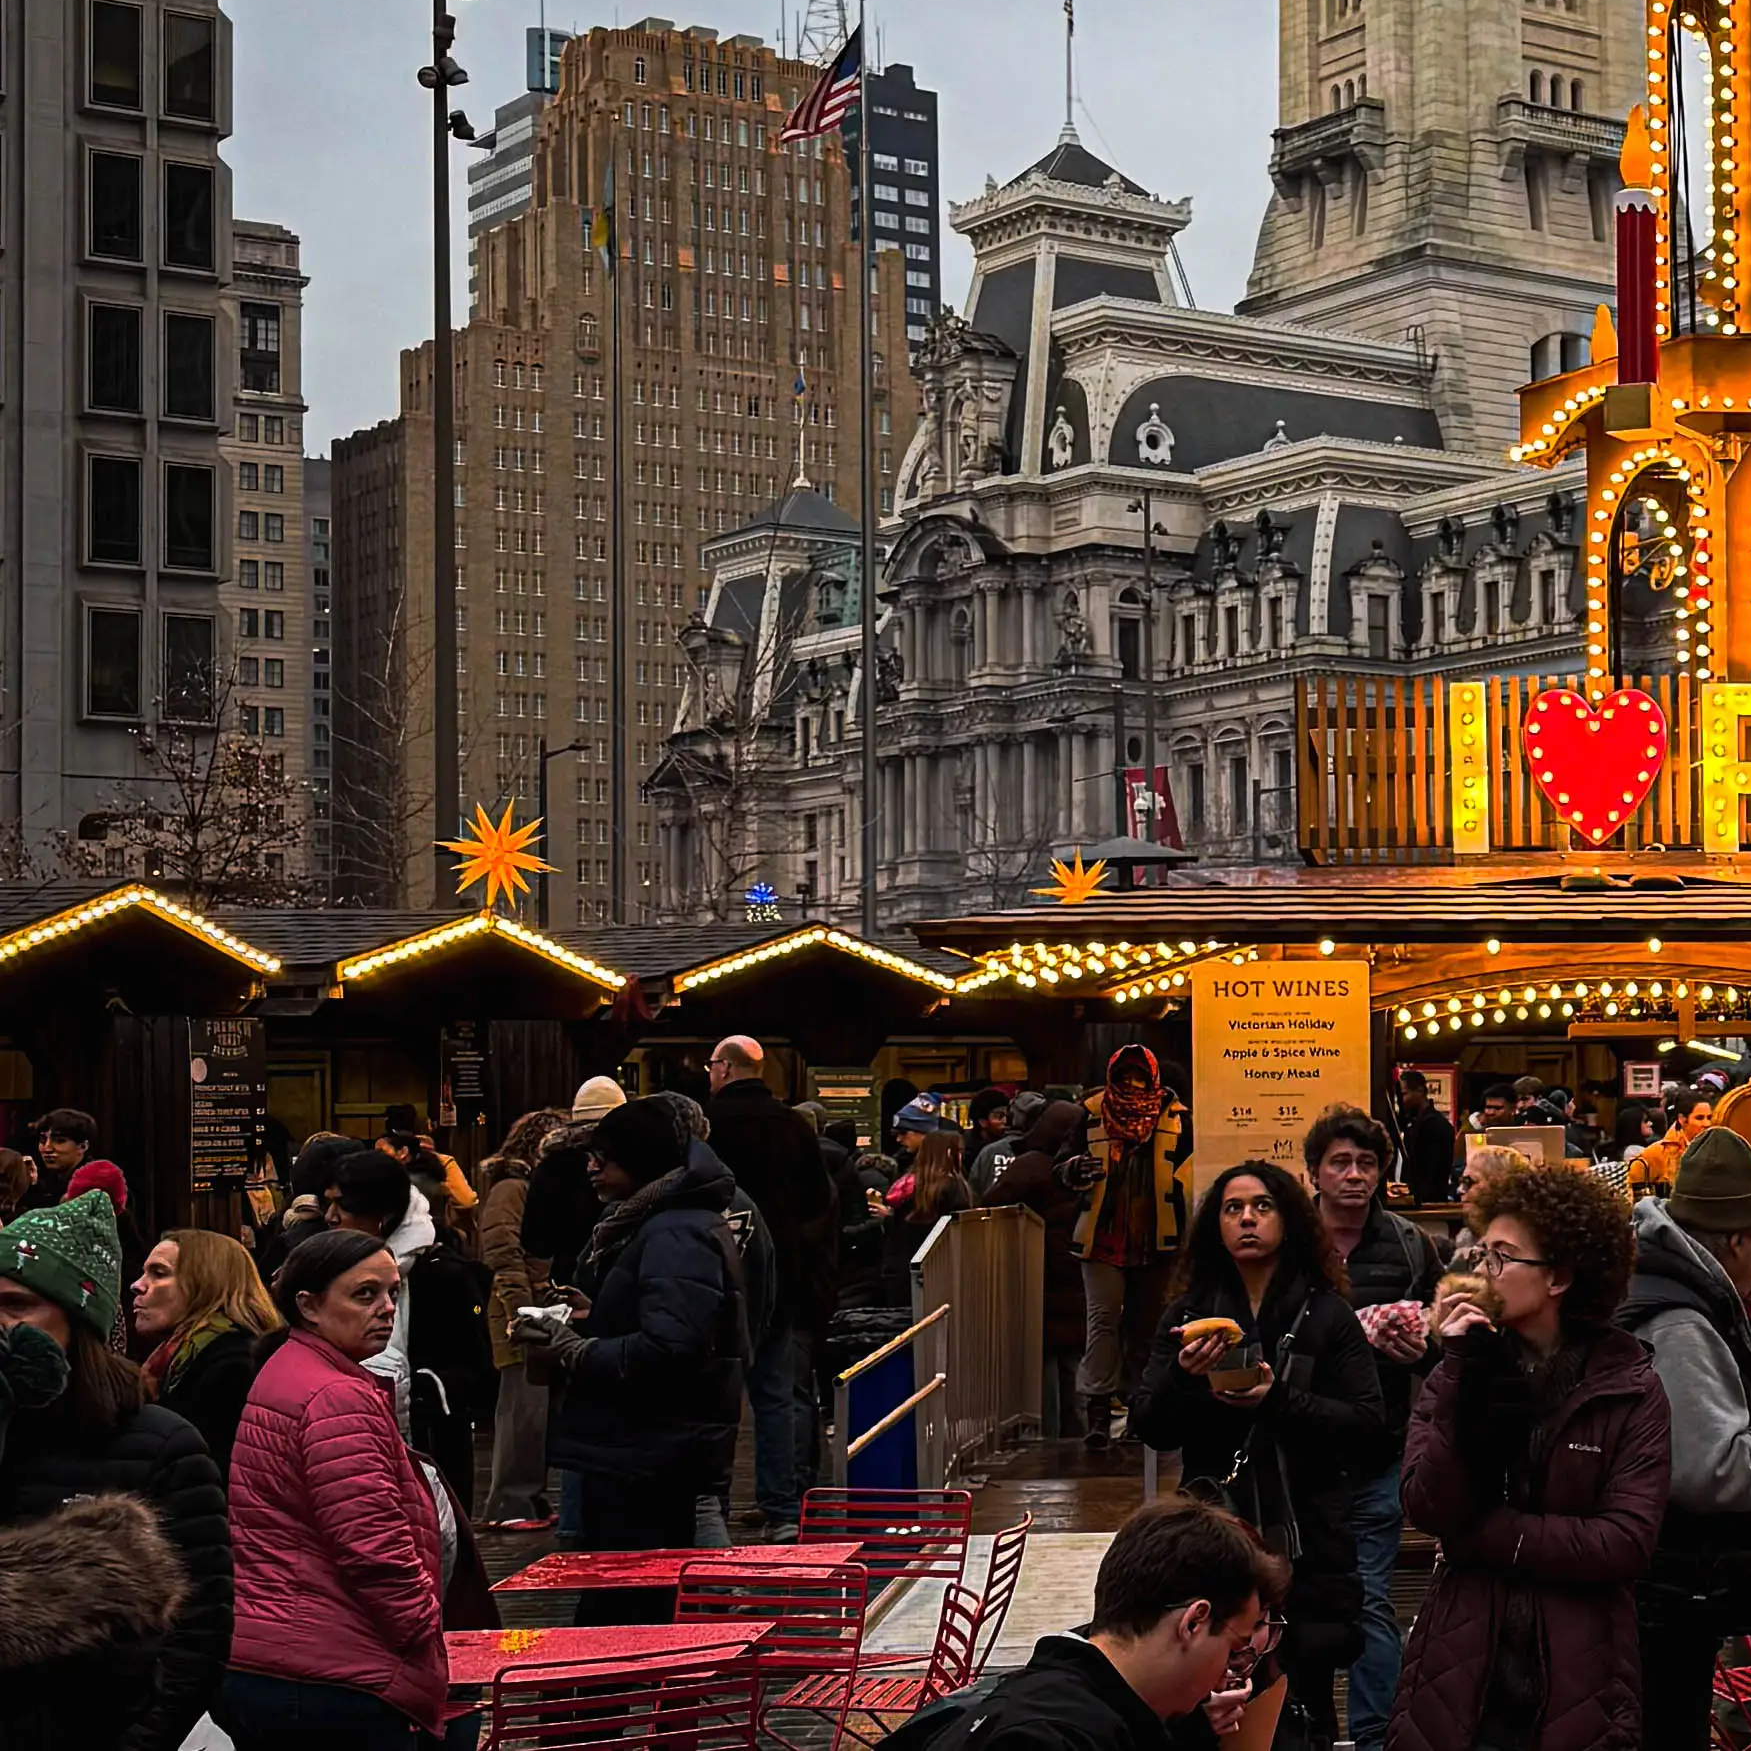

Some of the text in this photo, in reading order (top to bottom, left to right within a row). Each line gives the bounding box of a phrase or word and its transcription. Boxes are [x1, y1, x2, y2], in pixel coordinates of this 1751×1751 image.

[1449, 681, 1489, 854] I
[1213, 980, 1350, 997] HOT WINES
[1228, 1019, 1336, 1031] Victorian Holiday
[1223, 1046, 1341, 1060] Apple & Spice Wine
[1244, 1068, 1321, 1081] Honey Mead
